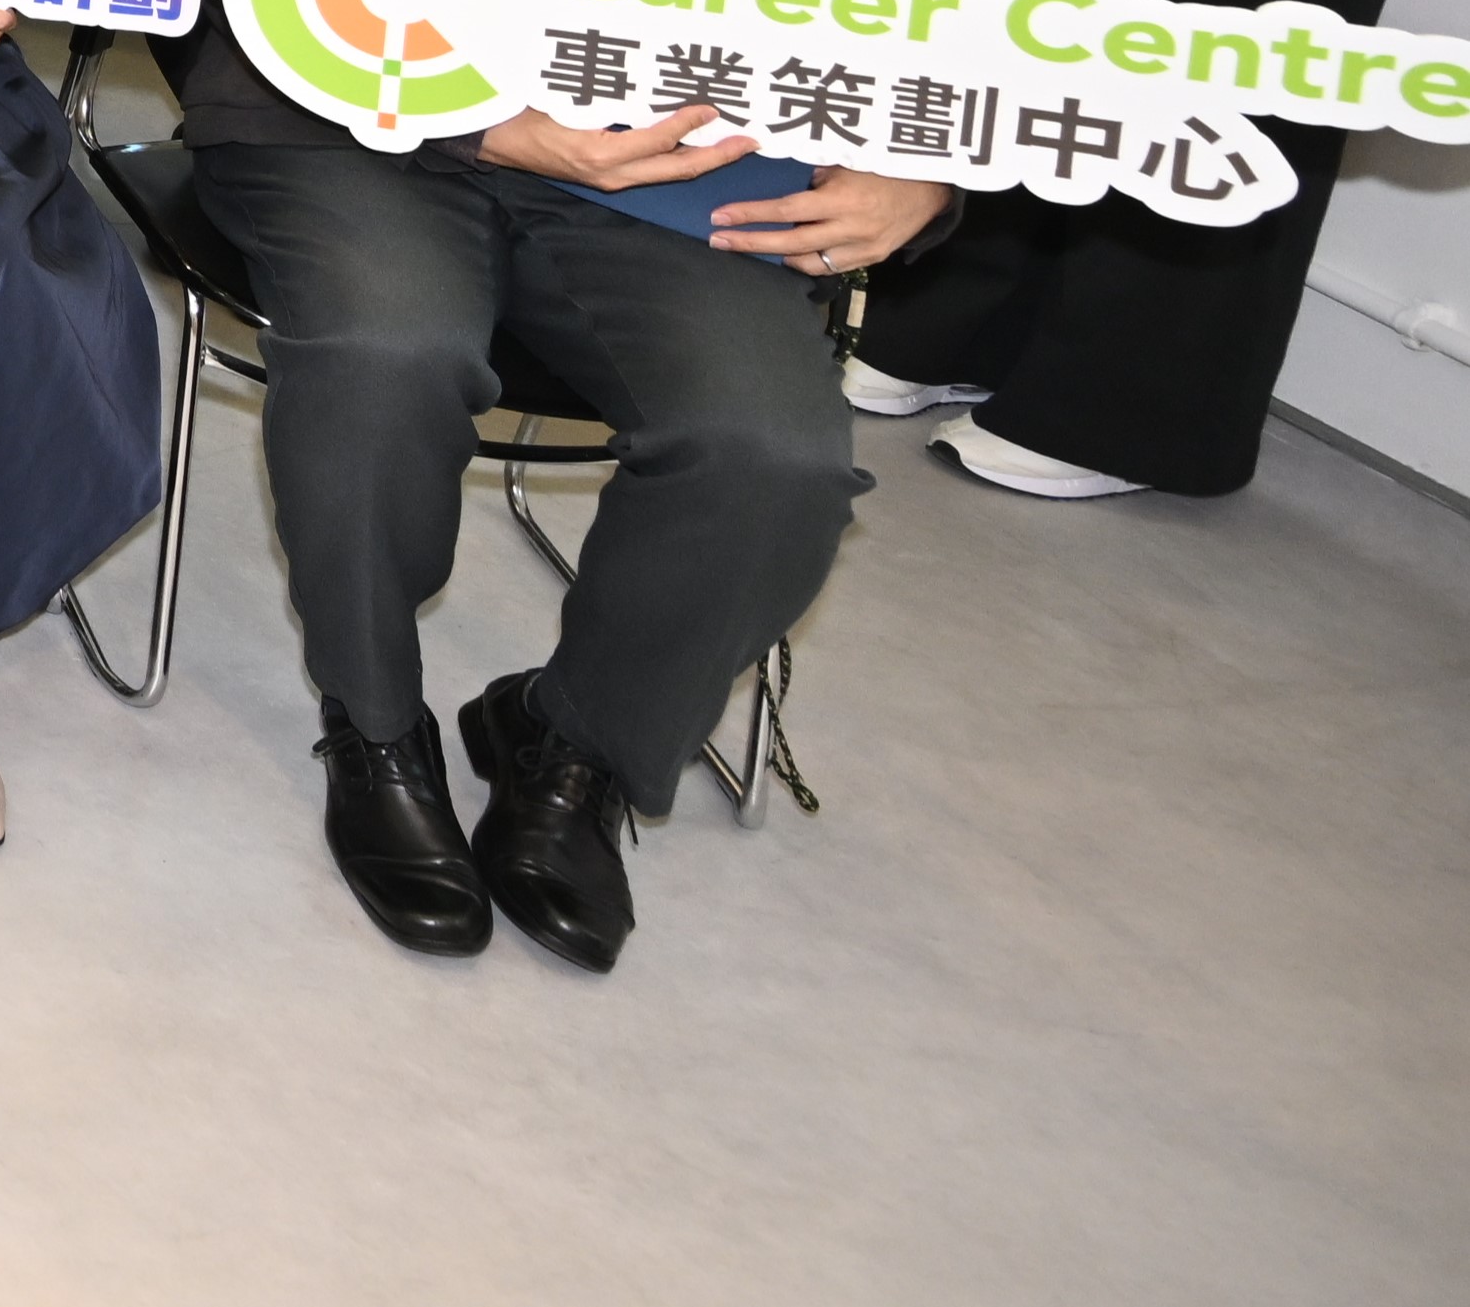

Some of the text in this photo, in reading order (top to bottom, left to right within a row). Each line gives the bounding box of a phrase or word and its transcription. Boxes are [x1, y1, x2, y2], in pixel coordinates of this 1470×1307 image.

[540, 28, 1259, 201] 事業策劃中心
